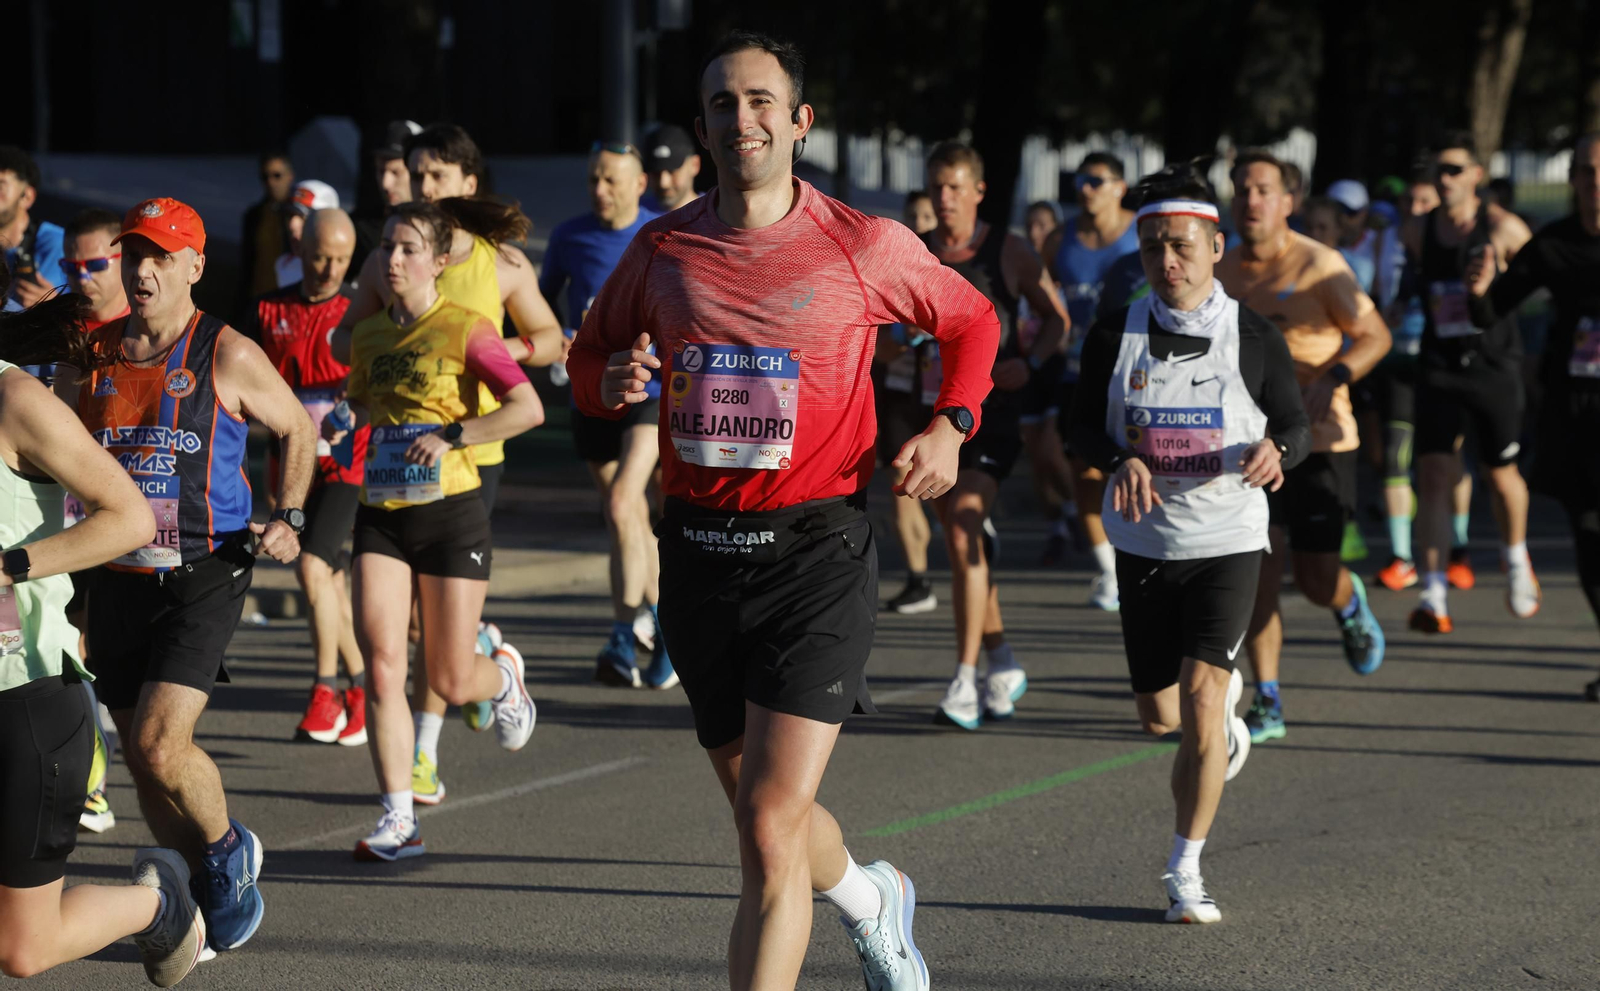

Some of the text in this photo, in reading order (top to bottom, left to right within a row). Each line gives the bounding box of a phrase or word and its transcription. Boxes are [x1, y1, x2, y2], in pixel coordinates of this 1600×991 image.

[710, 353, 783, 371] ZURICH
[711, 388, 750, 405] 9280
[670, 411, 794, 440] ALEJANDRO
[1156, 413, 1212, 425] ZURICH
[92, 425, 201, 454] TLETISMO
[1156, 438, 1191, 450] 10104
[117, 451, 177, 476] AMAS
[1138, 453, 1221, 473] ONGZHAO
[366, 466, 437, 484] MORGANE
[683, 526, 775, 546] MARLOAR
[717, 545, 738, 554] enjoy
